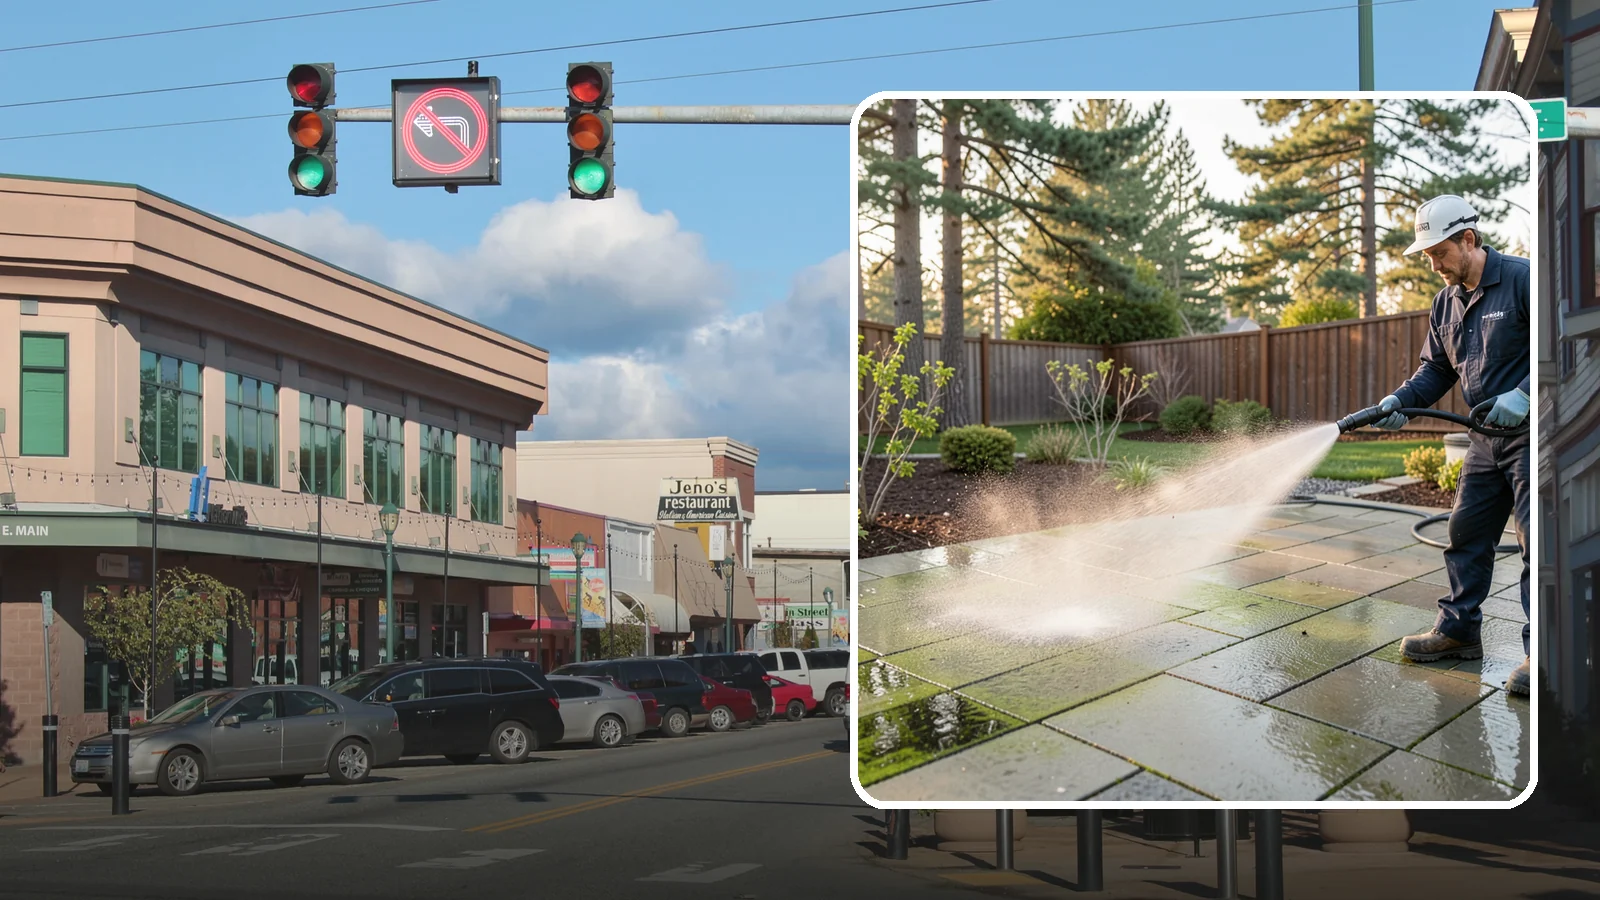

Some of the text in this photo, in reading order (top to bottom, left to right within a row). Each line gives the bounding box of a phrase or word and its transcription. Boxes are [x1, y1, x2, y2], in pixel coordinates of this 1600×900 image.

[669, 479, 728, 494] Jeno's
[665, 496, 731, 509] restaurant
[658, 510, 682, 520] Italian
[686, 509, 714, 519] American
[715, 509, 737, 519] Cuisine
[2, 525, 49, 536] E. MAIN
[797, 607, 829, 617] Street
[791, 619, 824, 627] lass
